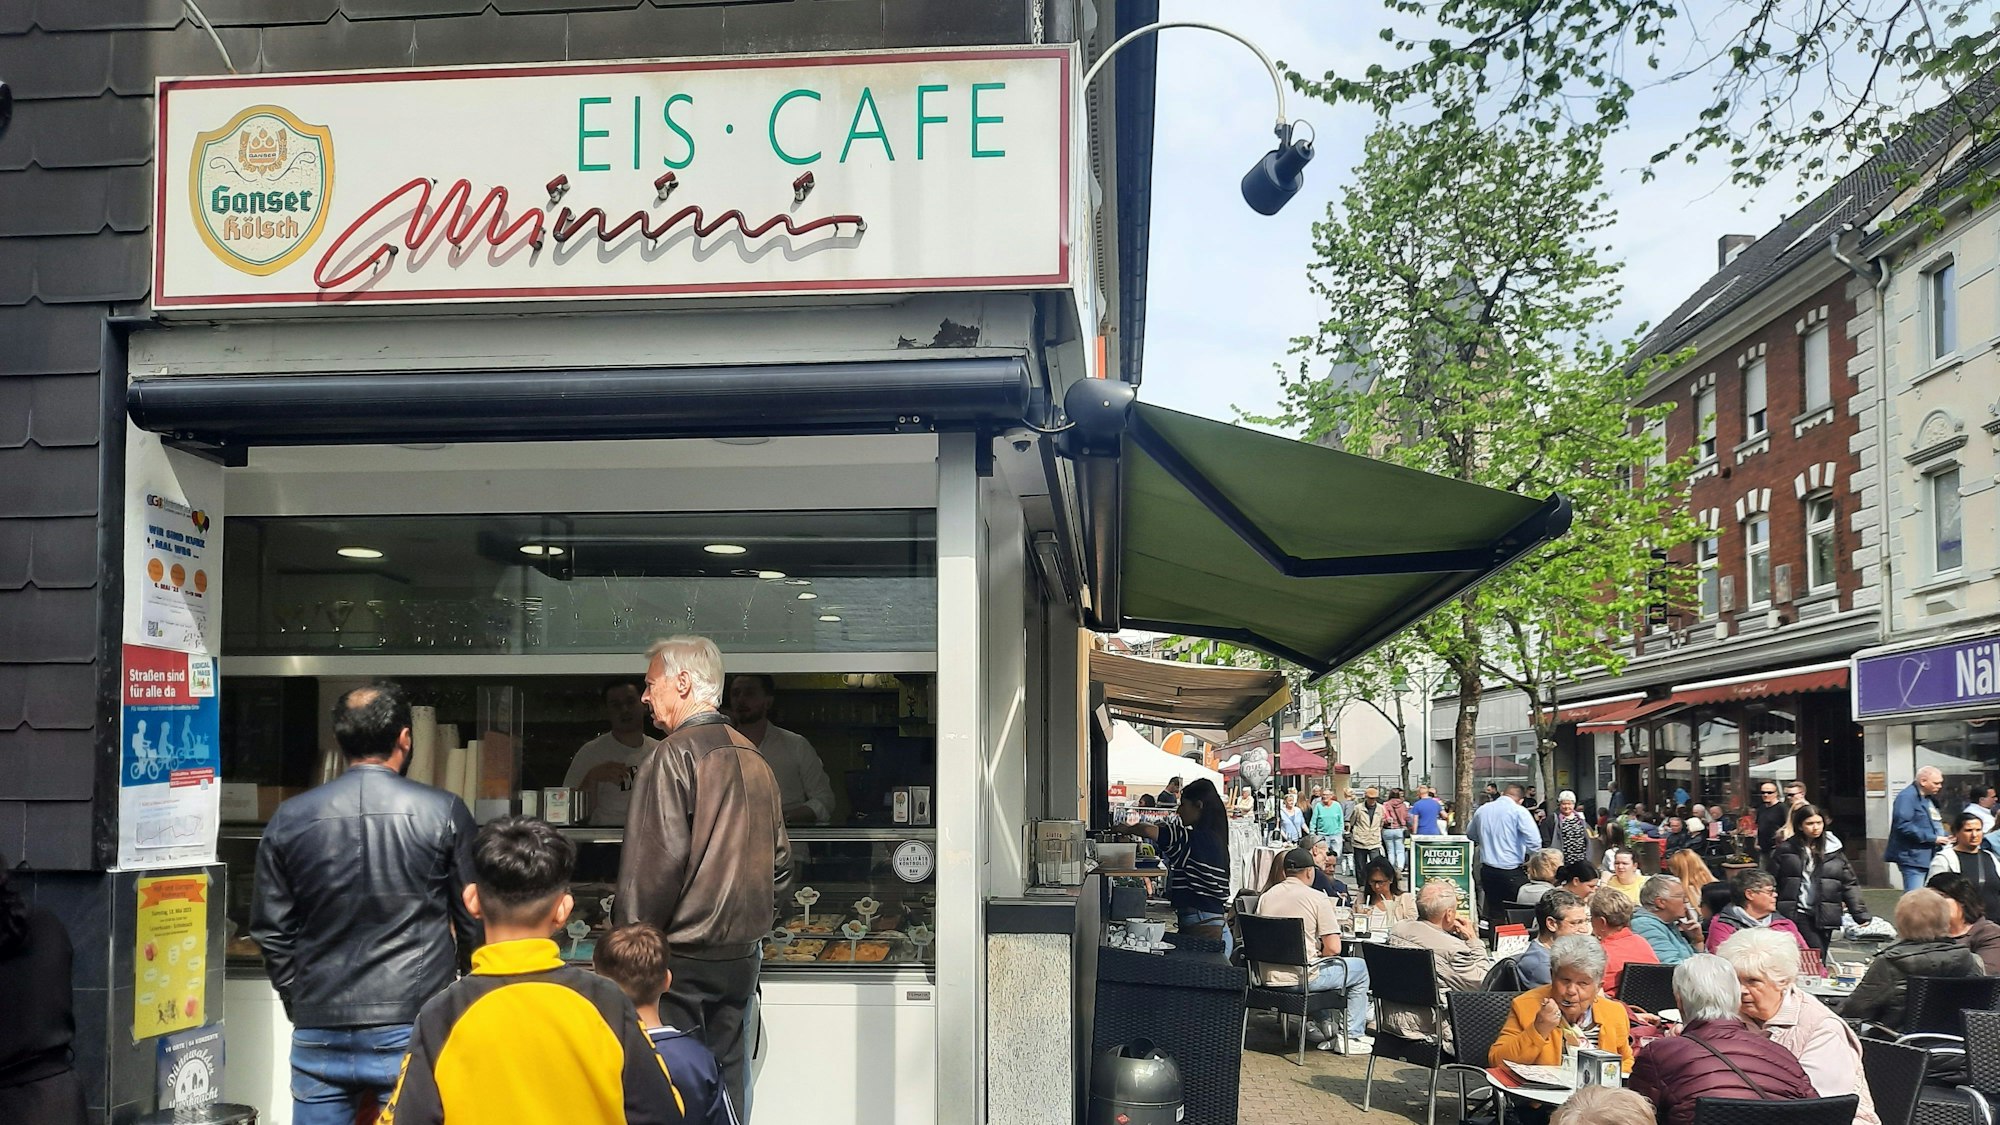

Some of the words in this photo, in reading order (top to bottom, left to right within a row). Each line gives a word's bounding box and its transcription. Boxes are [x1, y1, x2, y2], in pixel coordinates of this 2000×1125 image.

[578, 93, 696, 172] EIS
[768, 82, 1006, 166] CAFE
[211, 184, 313, 215] Ganser
[223, 214, 300, 241] Kölsch
[129, 668, 165, 682] Straßen
[166, 669, 185, 682] sind
[130, 685, 144, 698] für
[145, 685, 163, 698] alle
[164, 685, 176, 698] da
[1424, 849, 1462, 858] ALTGOLD-
[1427, 857, 1459, 865] ANKAUF
